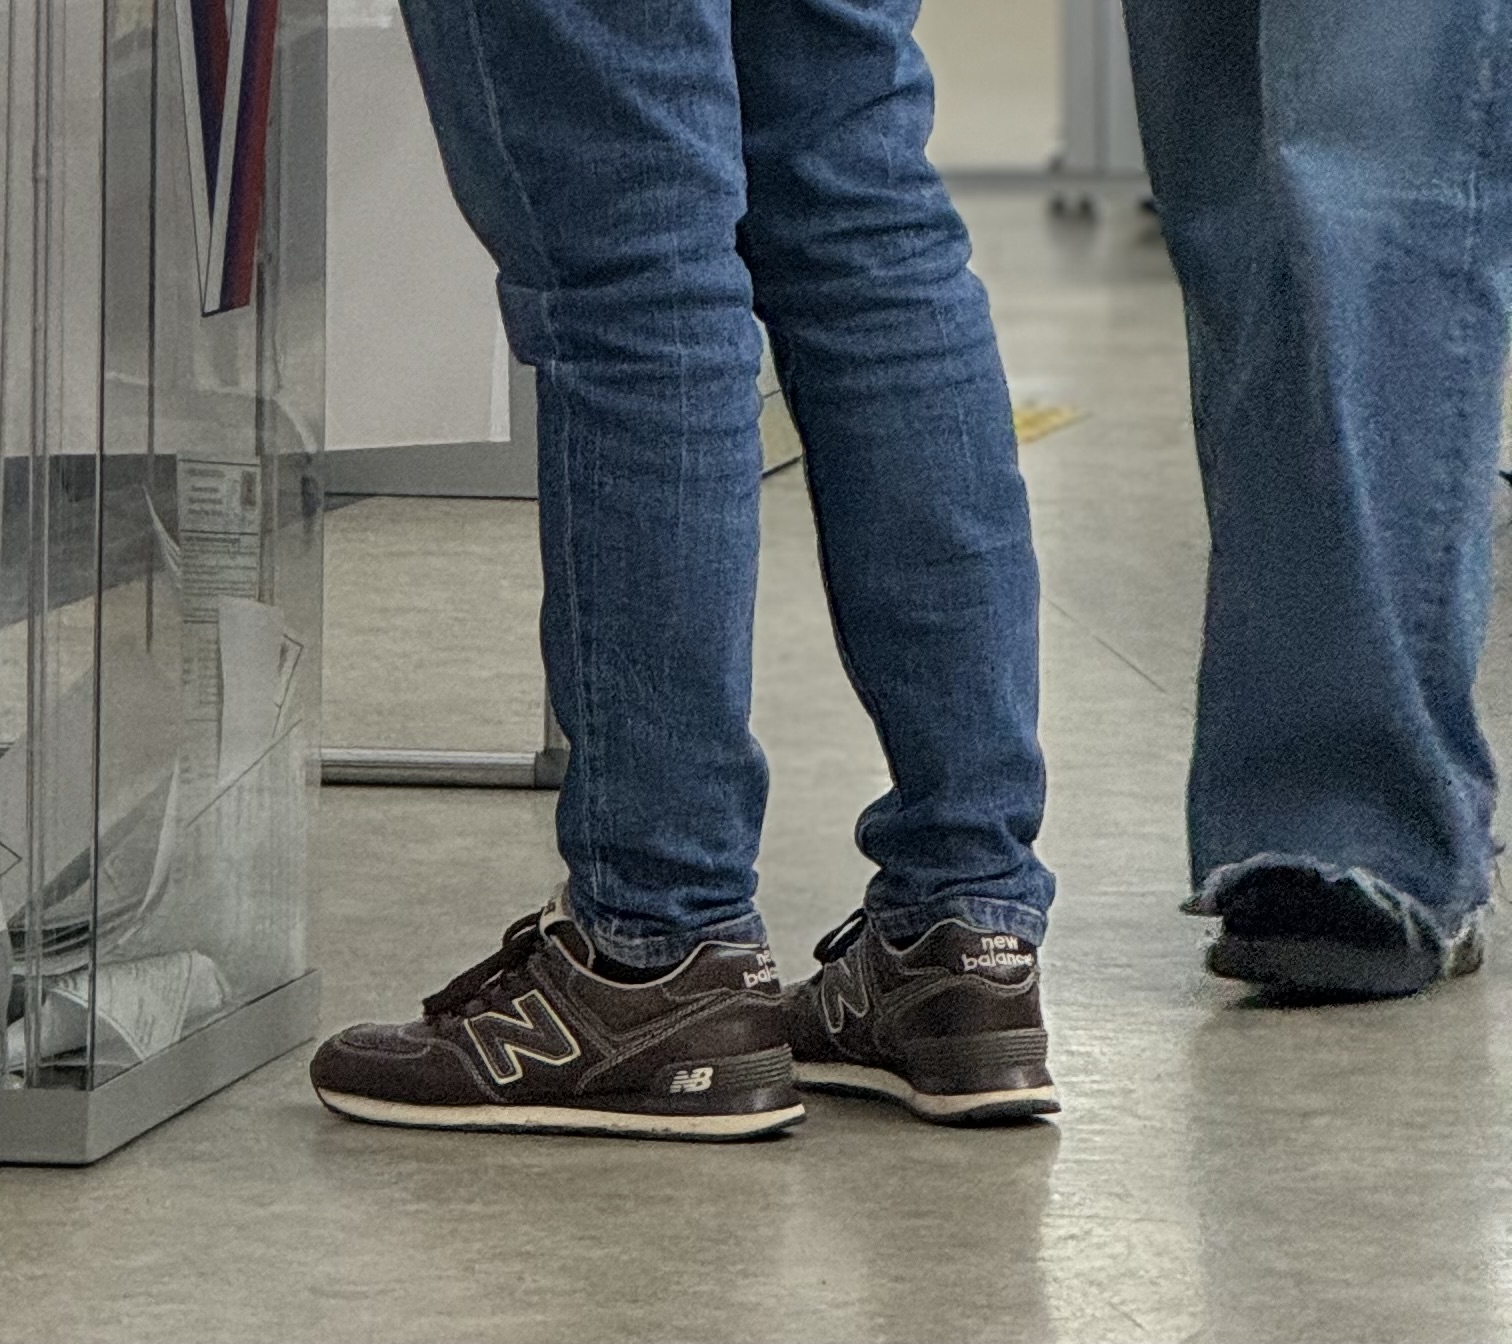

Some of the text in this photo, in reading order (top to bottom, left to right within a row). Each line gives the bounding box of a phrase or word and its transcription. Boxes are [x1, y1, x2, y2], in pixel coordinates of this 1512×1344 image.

[982, 935, 1019, 951] new
[962, 951, 1034, 971] balance
[463, 988, 581, 1085] N
